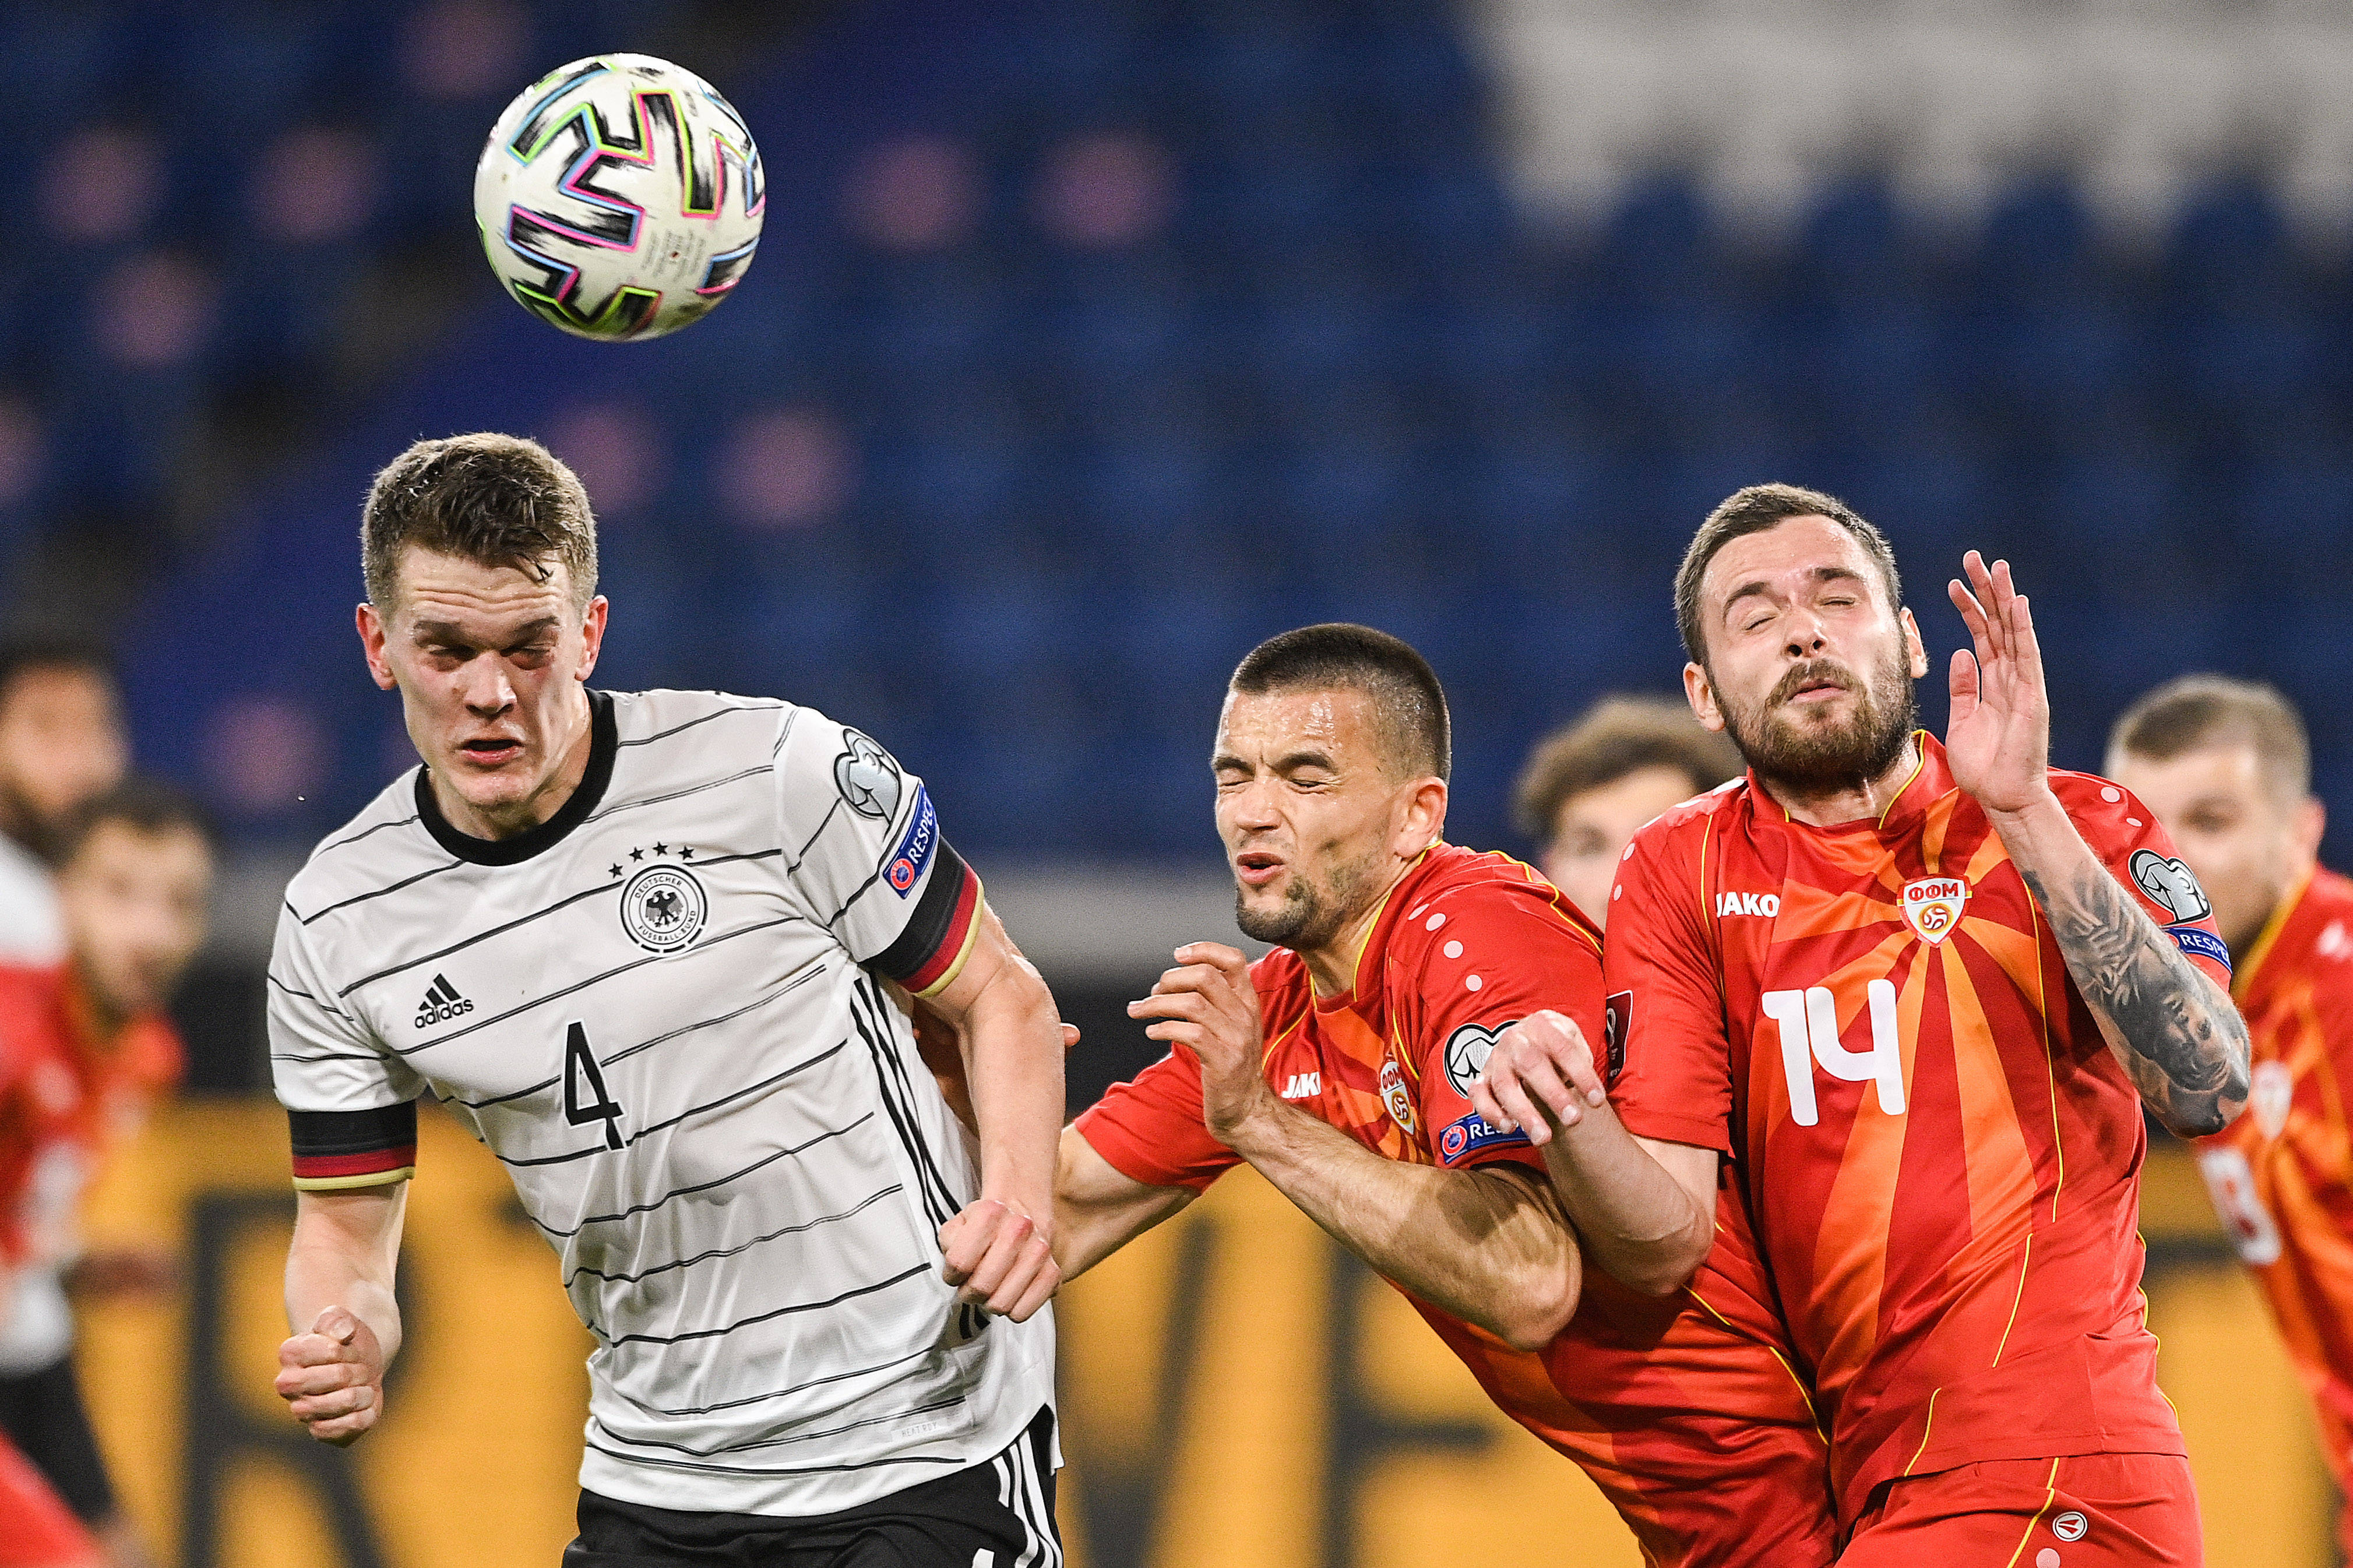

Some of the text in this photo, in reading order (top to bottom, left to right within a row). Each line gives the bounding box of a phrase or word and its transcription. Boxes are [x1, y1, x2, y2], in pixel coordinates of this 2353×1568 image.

[908, 791, 934, 864] RESPECT
[635, 876, 682, 898] DEUTSCHER
[1716, 892, 1780, 918] JAKO
[638, 910, 696, 942] FUSSBALL-BUND
[2179, 934, 2231, 967] RESPE
[414, 999, 475, 1029] adidas
[1762, 978, 1906, 1127] 14
[563, 1021, 625, 1151] 4
[1282, 1071, 1322, 1099] JAK
